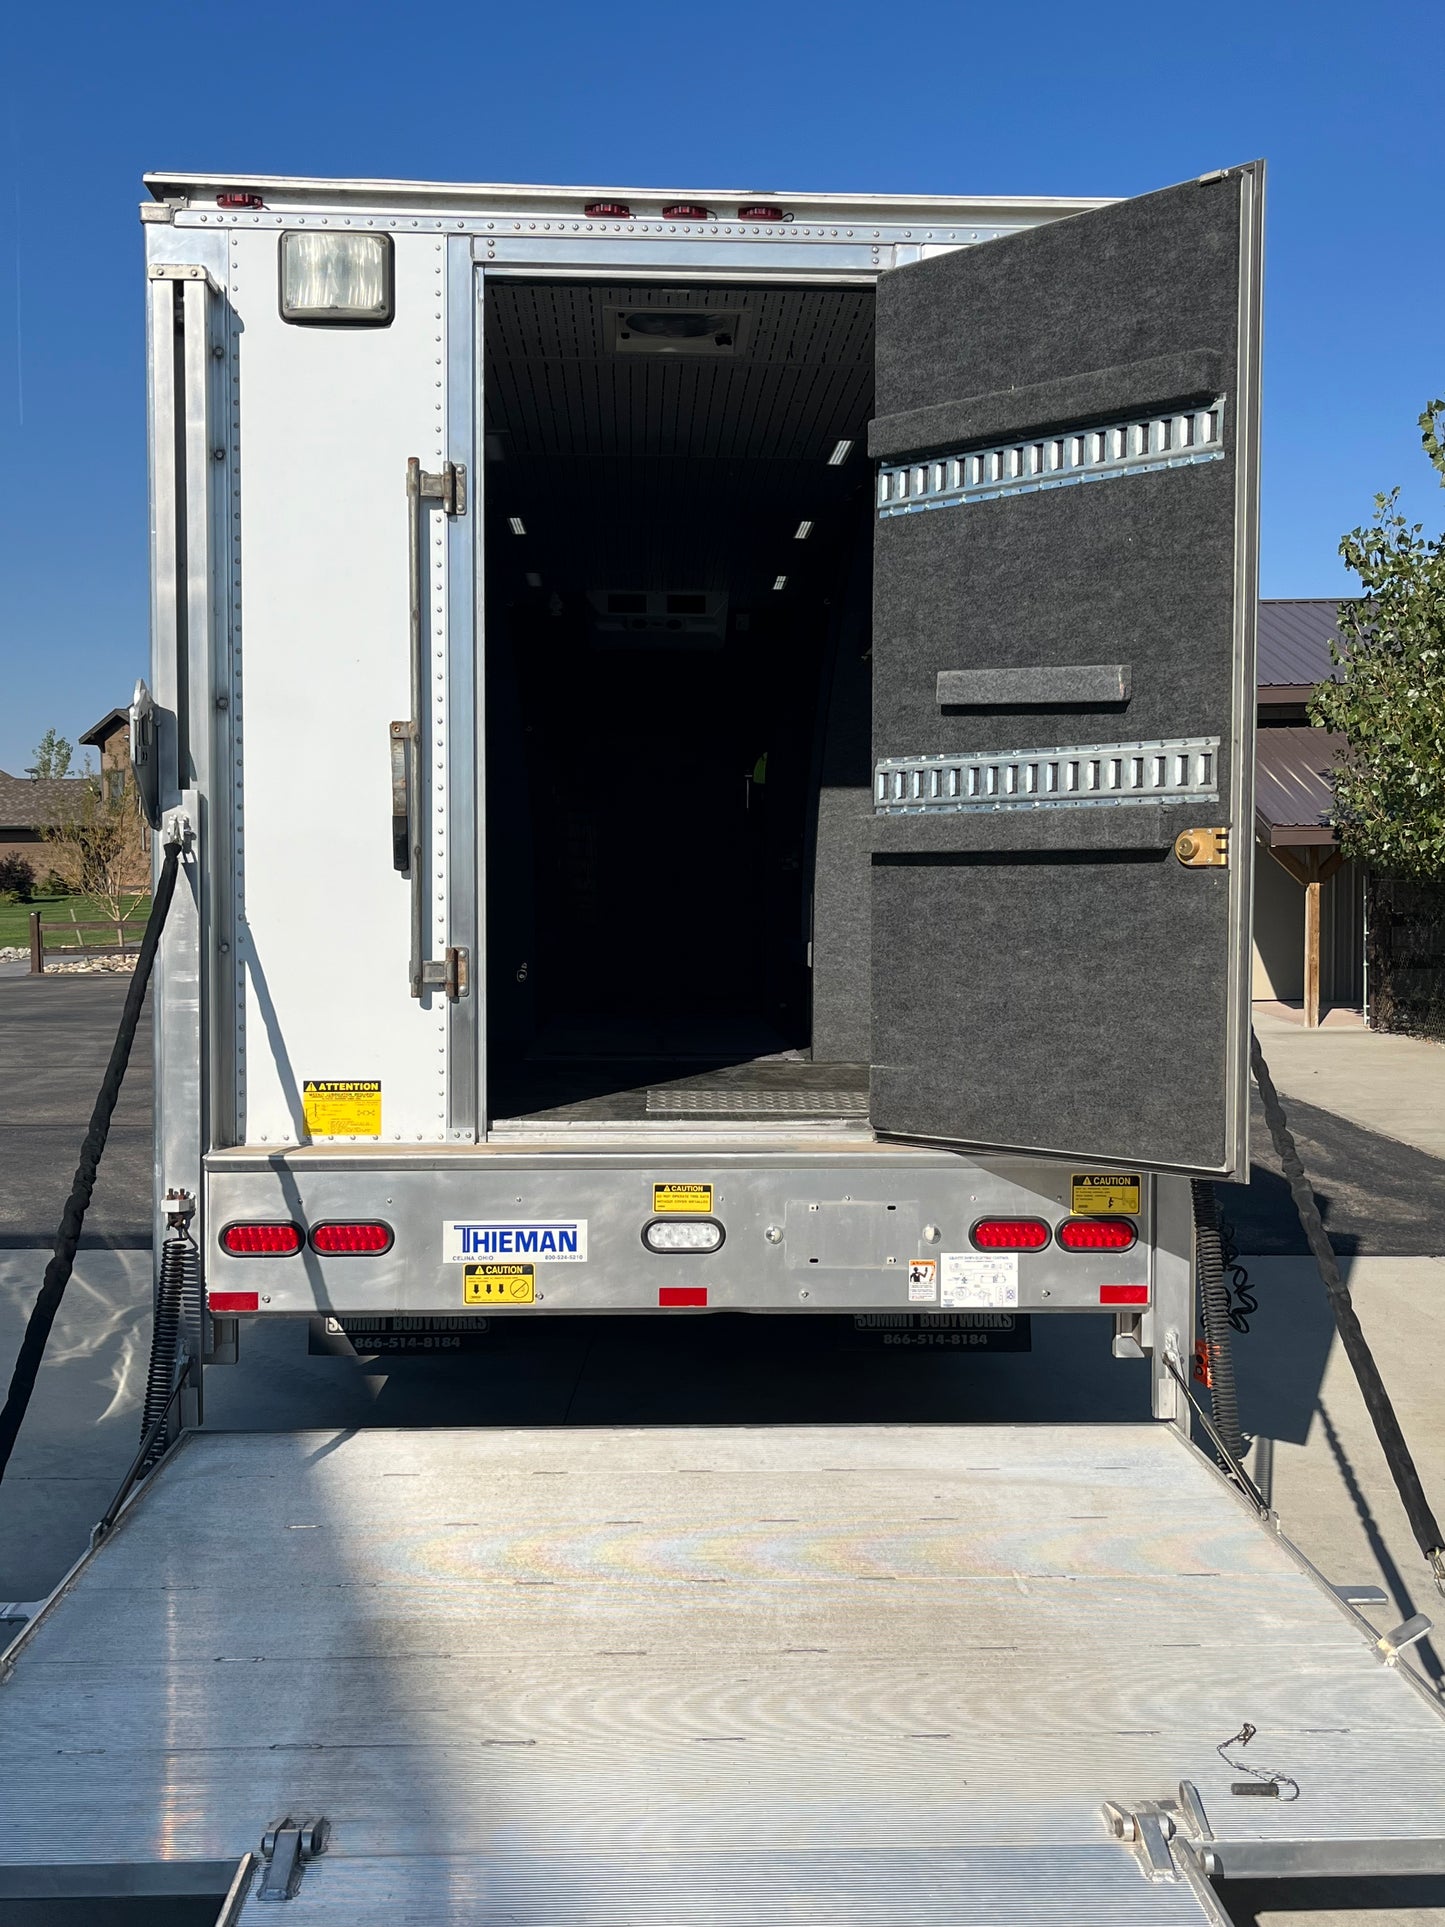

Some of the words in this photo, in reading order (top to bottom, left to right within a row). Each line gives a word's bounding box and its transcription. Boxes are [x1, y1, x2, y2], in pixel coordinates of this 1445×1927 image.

[319, 1082, 379, 1091] ATTENTION
[1093, 1177, 1131, 1186] CAUTION
[454, 1224, 577, 1253] THIEMAN
[485, 1265, 523, 1274] CAUTION
[328, 1316, 387, 1332] SUMMIT
[392, 1315, 488, 1331] BODYWORKS
[857, 1313, 914, 1328] SUMMIT
[920, 1313, 1013, 1328] BODYWORKS
[354, 1336, 461, 1349] 866-514-8184
[883, 1333, 988, 1345] 866-514-8184
